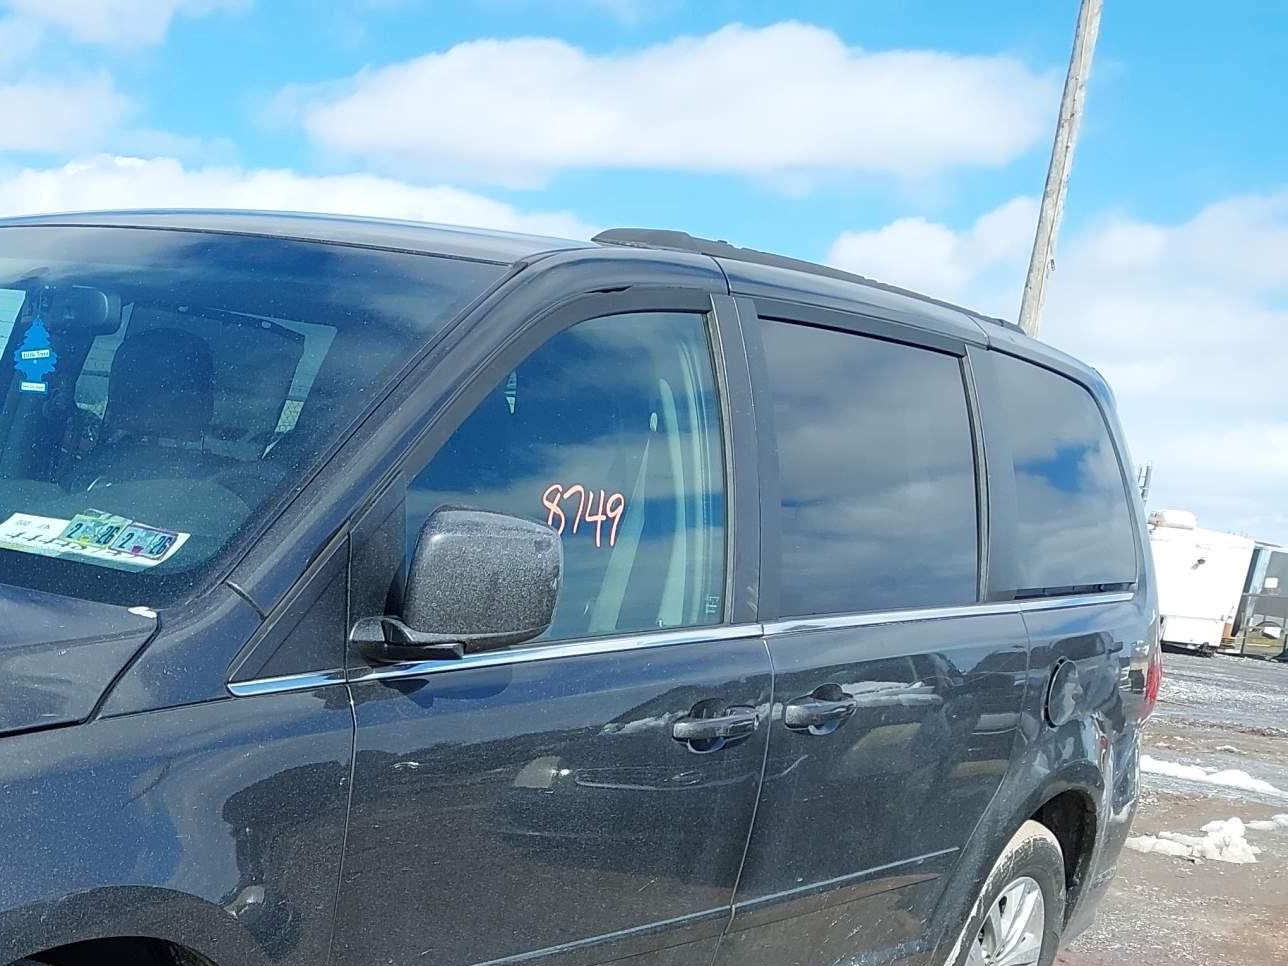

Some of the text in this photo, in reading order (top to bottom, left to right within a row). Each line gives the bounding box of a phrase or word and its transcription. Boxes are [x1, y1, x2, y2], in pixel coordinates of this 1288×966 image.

[543, 484, 625, 548] 8749
[66, 522, 120, 545] 2 26
[118, 532, 173, 555] 2 26
